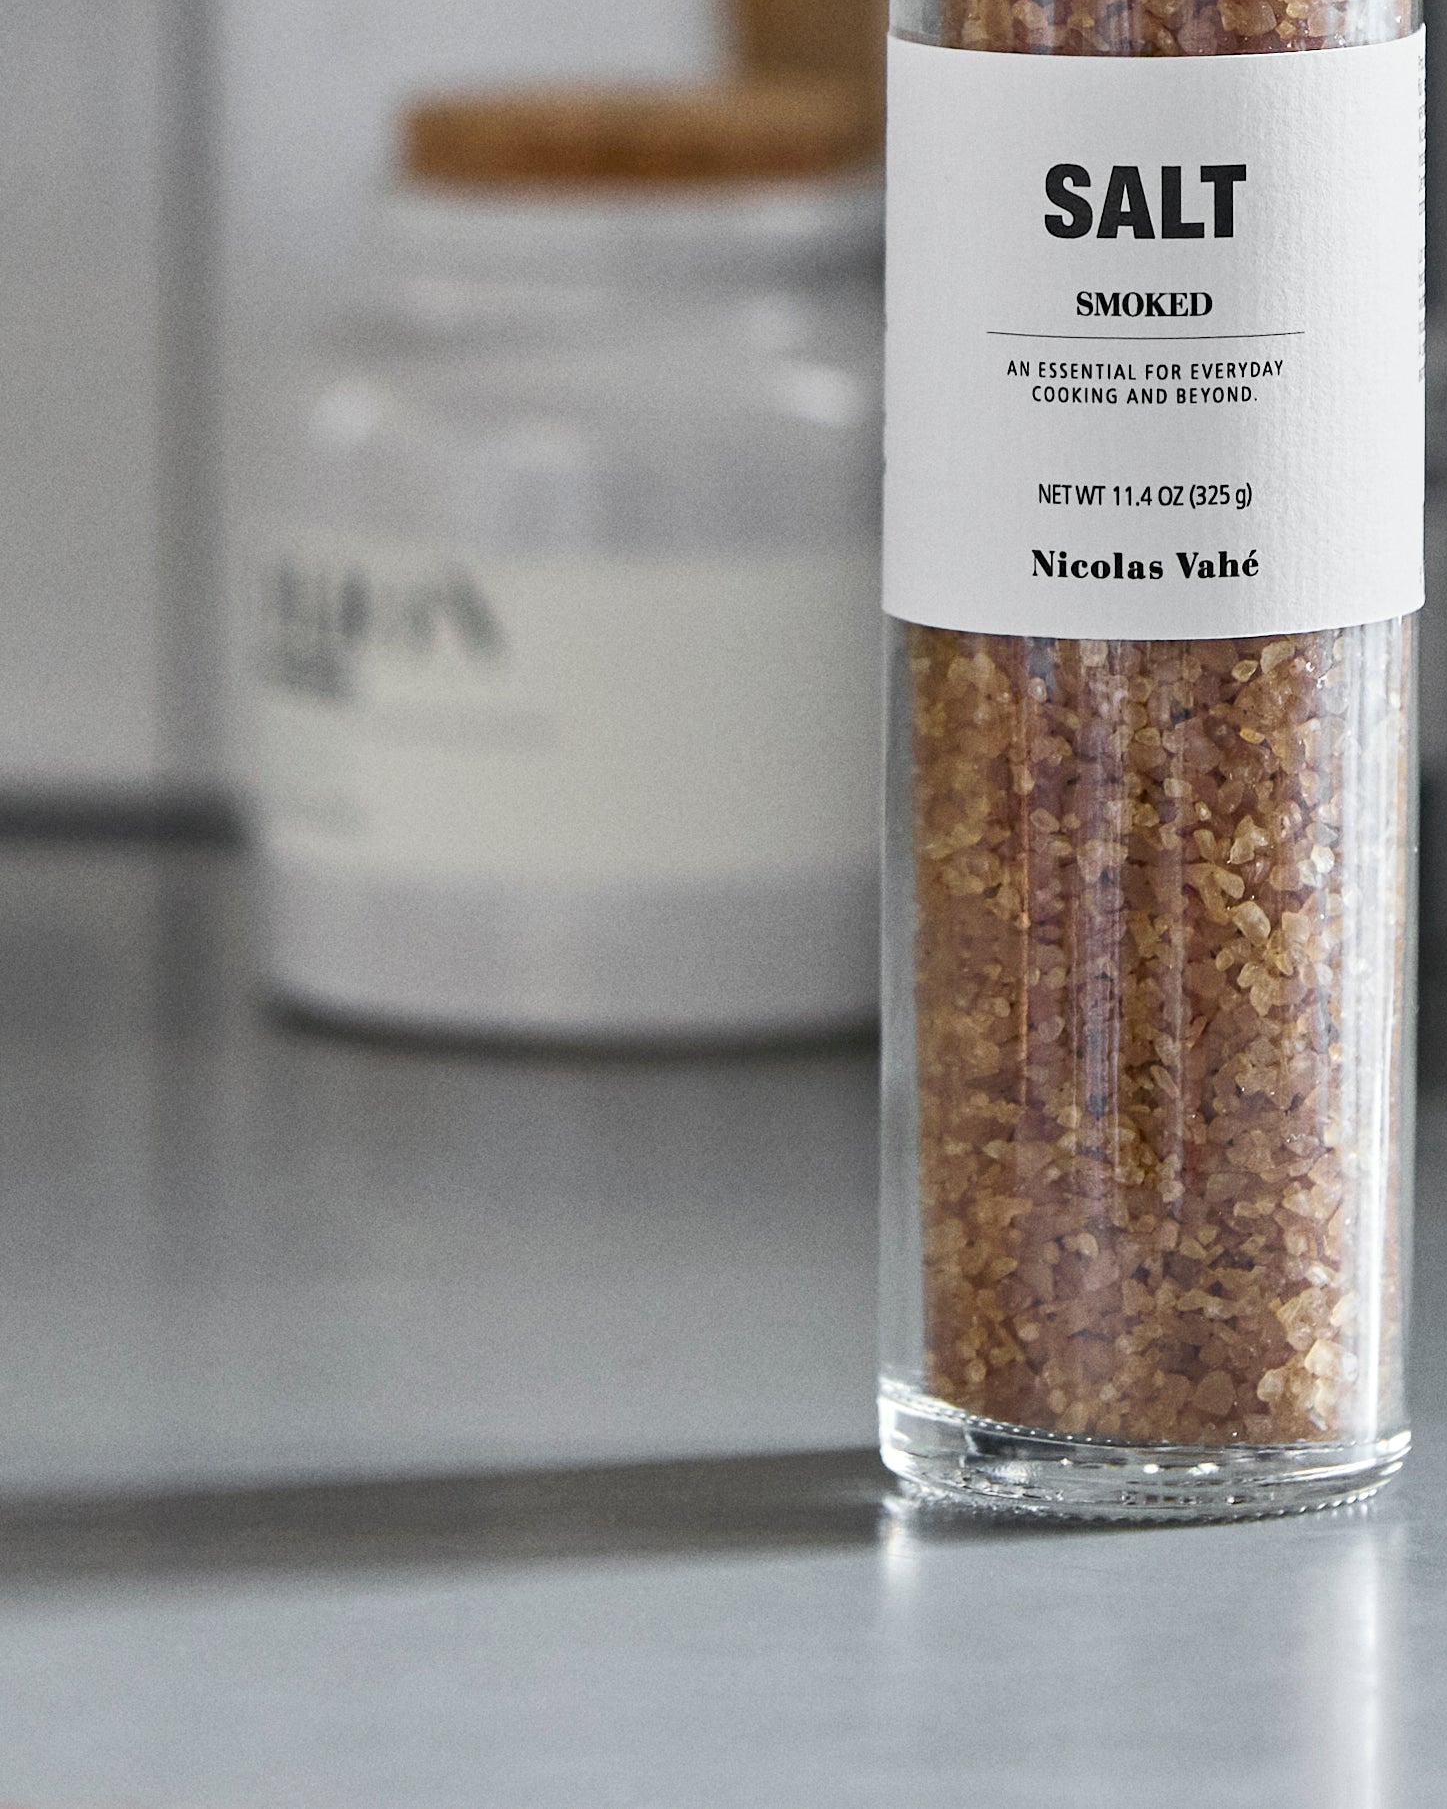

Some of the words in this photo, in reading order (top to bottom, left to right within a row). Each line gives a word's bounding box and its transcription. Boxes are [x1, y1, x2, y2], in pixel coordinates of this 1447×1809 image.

[1044, 163, 1247, 240] SALT
[1075, 290, 1214, 318] SMOKED
[1006, 359, 1031, 378] AN
[1038, 361, 1137, 381] ESSENTIAL
[1145, 363, 1182, 381] FOR
[1190, 359, 1284, 381] EVERYDAY
[1031, 385, 1118, 405] COOKING
[1126, 387, 1168, 405] AND
[1176, 385, 1258, 404] BEYOND.
[1038, 483, 1073, 506] NET
[1074, 484, 1107, 506] WT
[1112, 485, 1153, 507] 11.4
[1157, 485, 1185, 507] OZ
[1189, 483, 1231, 510] (325
[1235, 481, 1253, 511] g)
[1031, 549, 1164, 581] Nicolas
[1175, 548, 1260, 580] Vahé
